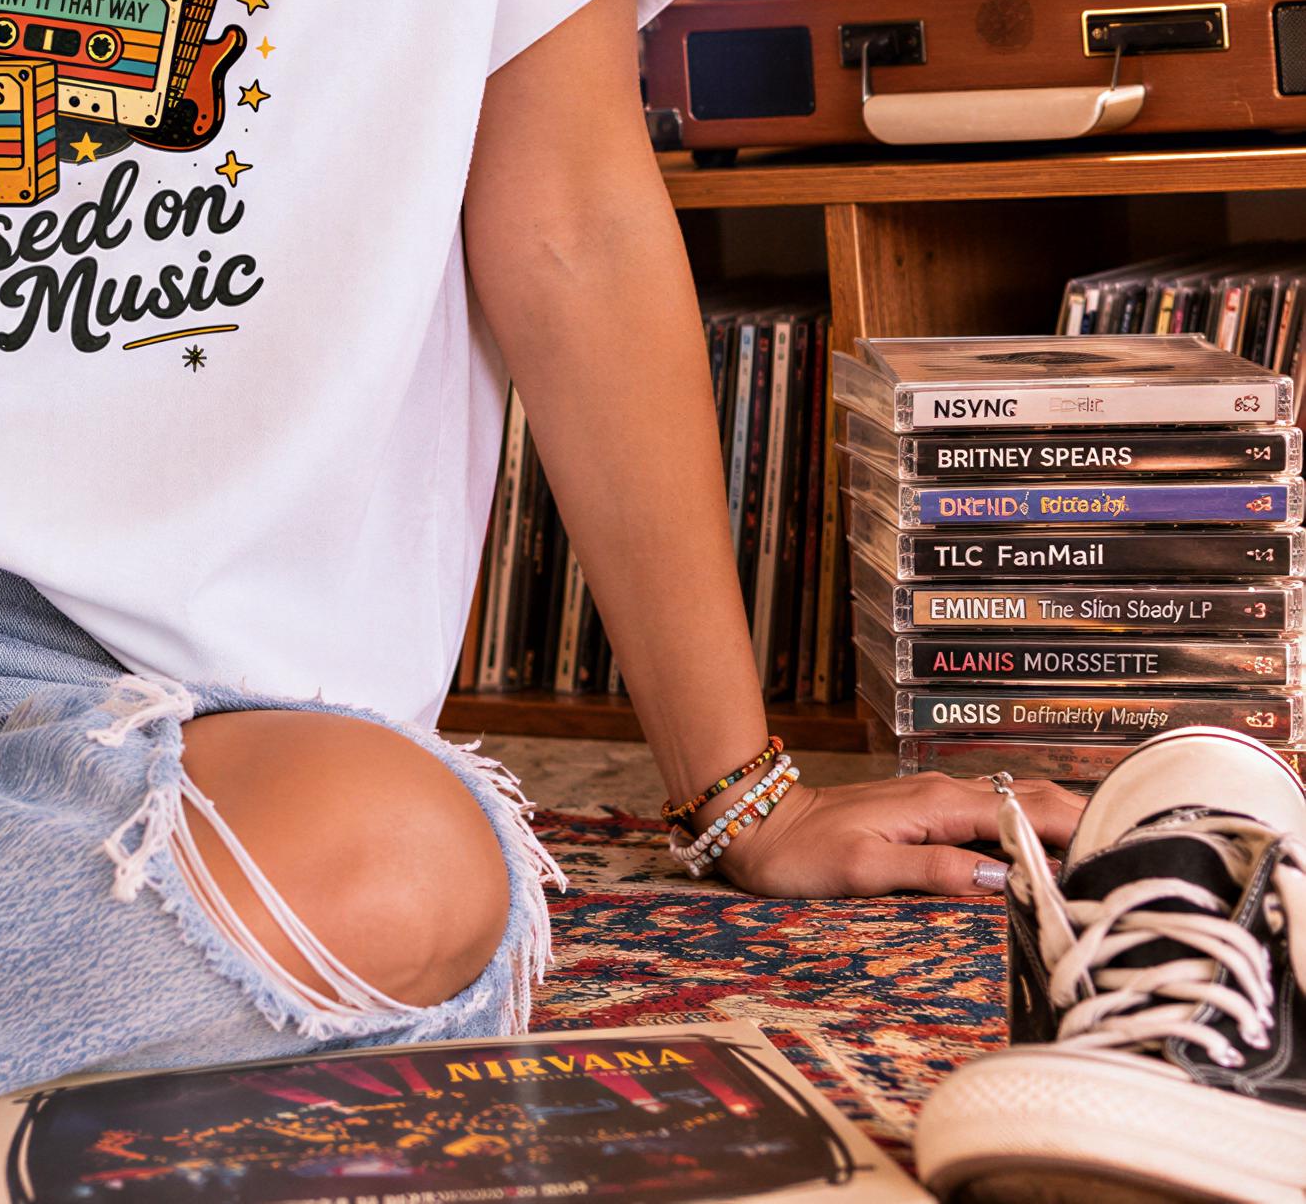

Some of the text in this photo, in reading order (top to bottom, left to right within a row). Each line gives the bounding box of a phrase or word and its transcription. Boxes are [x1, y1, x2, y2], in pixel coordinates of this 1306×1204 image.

[109, 0, 150, 24] WAY
[143, 183, 245, 242] on
[937, 446, 1133, 468] BRITNEY SPEARS
[933, 544, 1104, 567] TLC FanMail
[929, 597, 1027, 620] EMINEM
[1189, 600, 1213, 619] LP
[933, 651, 1159, 674] ALANIS MORSSETTE
[932, 702, 1002, 725] OASIS
[445, 1047, 695, 1083] NIRVANA
